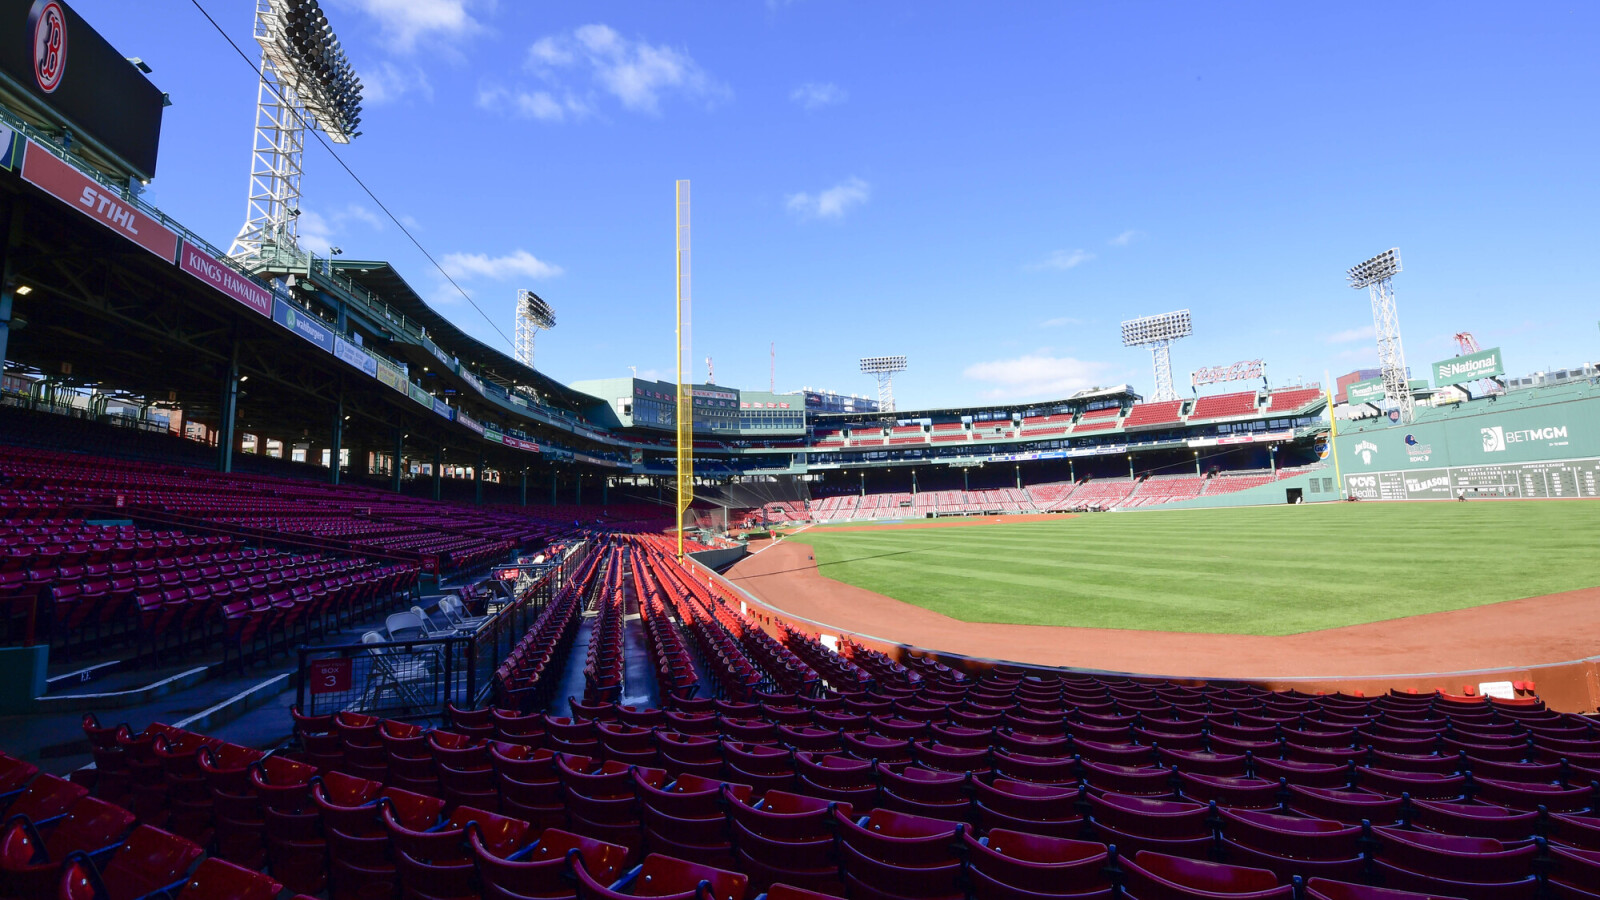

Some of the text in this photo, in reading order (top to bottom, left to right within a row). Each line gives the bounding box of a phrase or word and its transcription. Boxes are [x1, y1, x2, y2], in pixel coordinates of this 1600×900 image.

[40, 10, 61, 82] B
[79, 185, 139, 235] STIHL
[189, 252, 268, 309] KING'S HAWAIIAN
[1451, 354, 1496, 376] National
[1505, 425, 1568, 443] BETMGM
[1357, 475, 1376, 488] CVS
[1351, 487, 1378, 498] Health
[321, 667, 339, 675] BOX
[324, 675, 337, 687] 3
